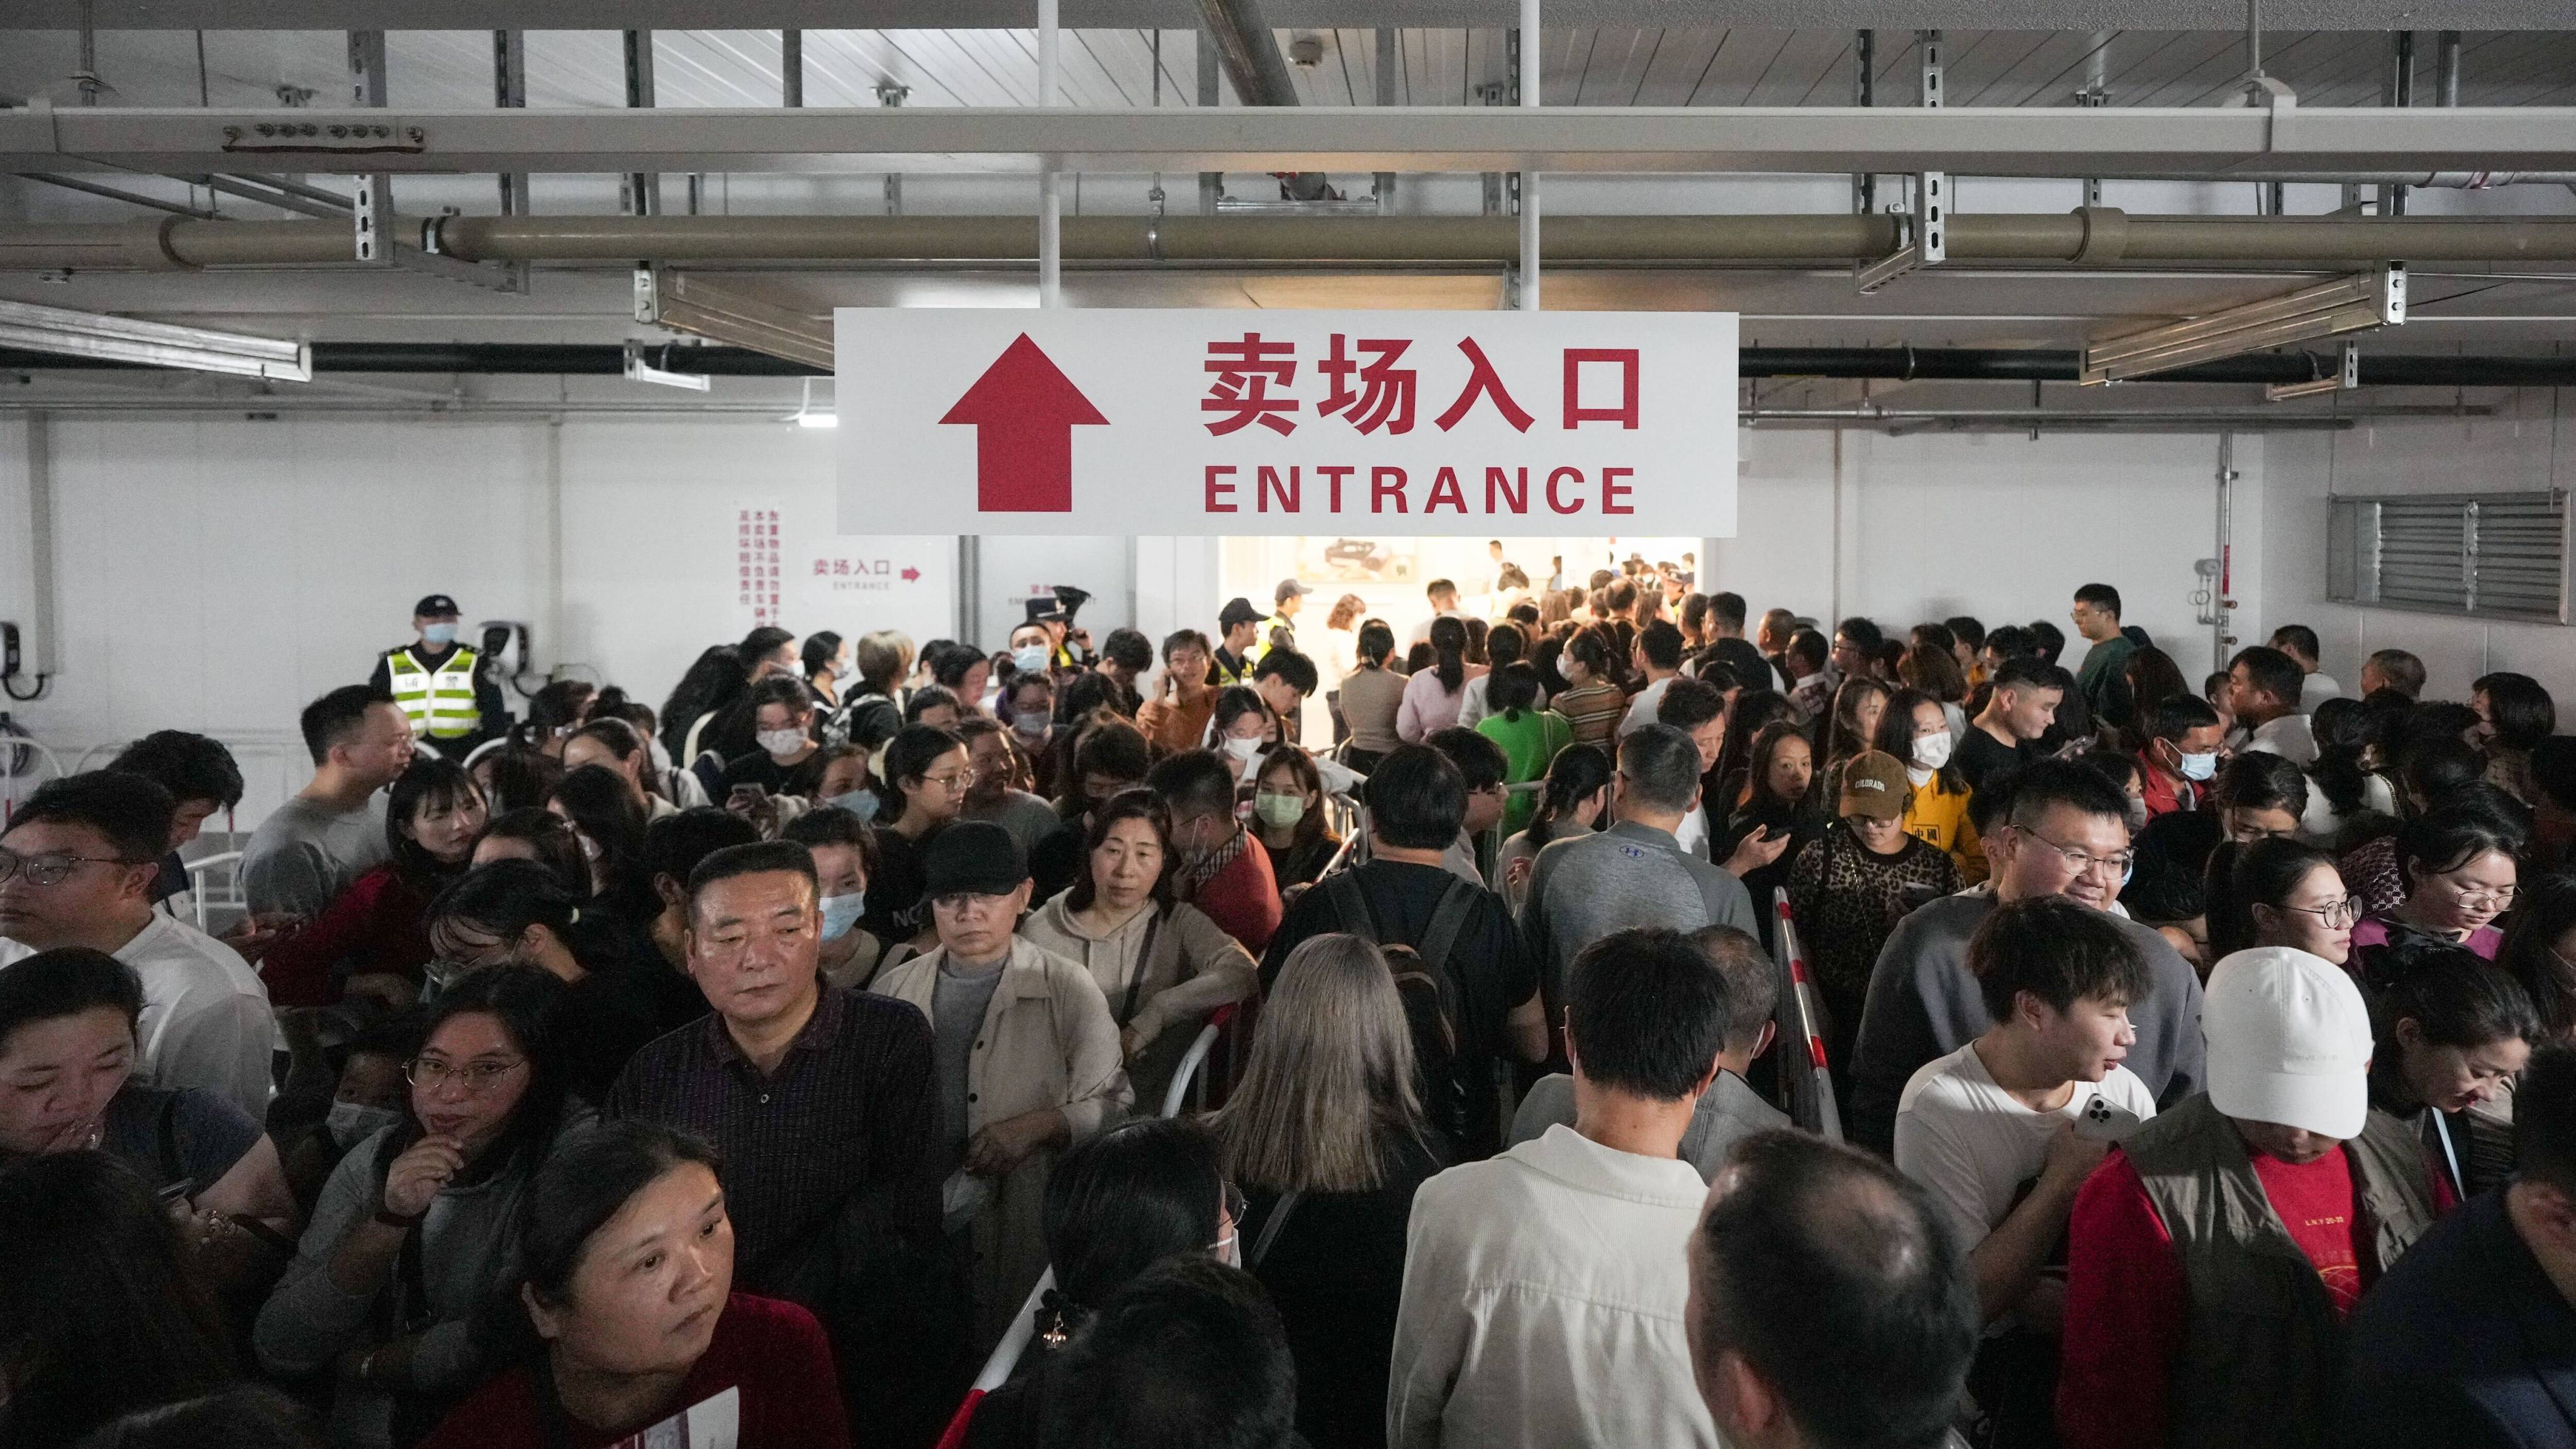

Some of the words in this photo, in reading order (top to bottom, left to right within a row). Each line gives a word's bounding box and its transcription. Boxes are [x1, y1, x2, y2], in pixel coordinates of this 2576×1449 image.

[1202, 333, 1640, 437] 卖场入口
[1206, 466, 1635, 515] ENTRANCE
[814, 559, 889, 576] 卖场入口
[833, 581, 889, 591] ENTRANCE
[1855, 779, 1885, 792] COLORADO
